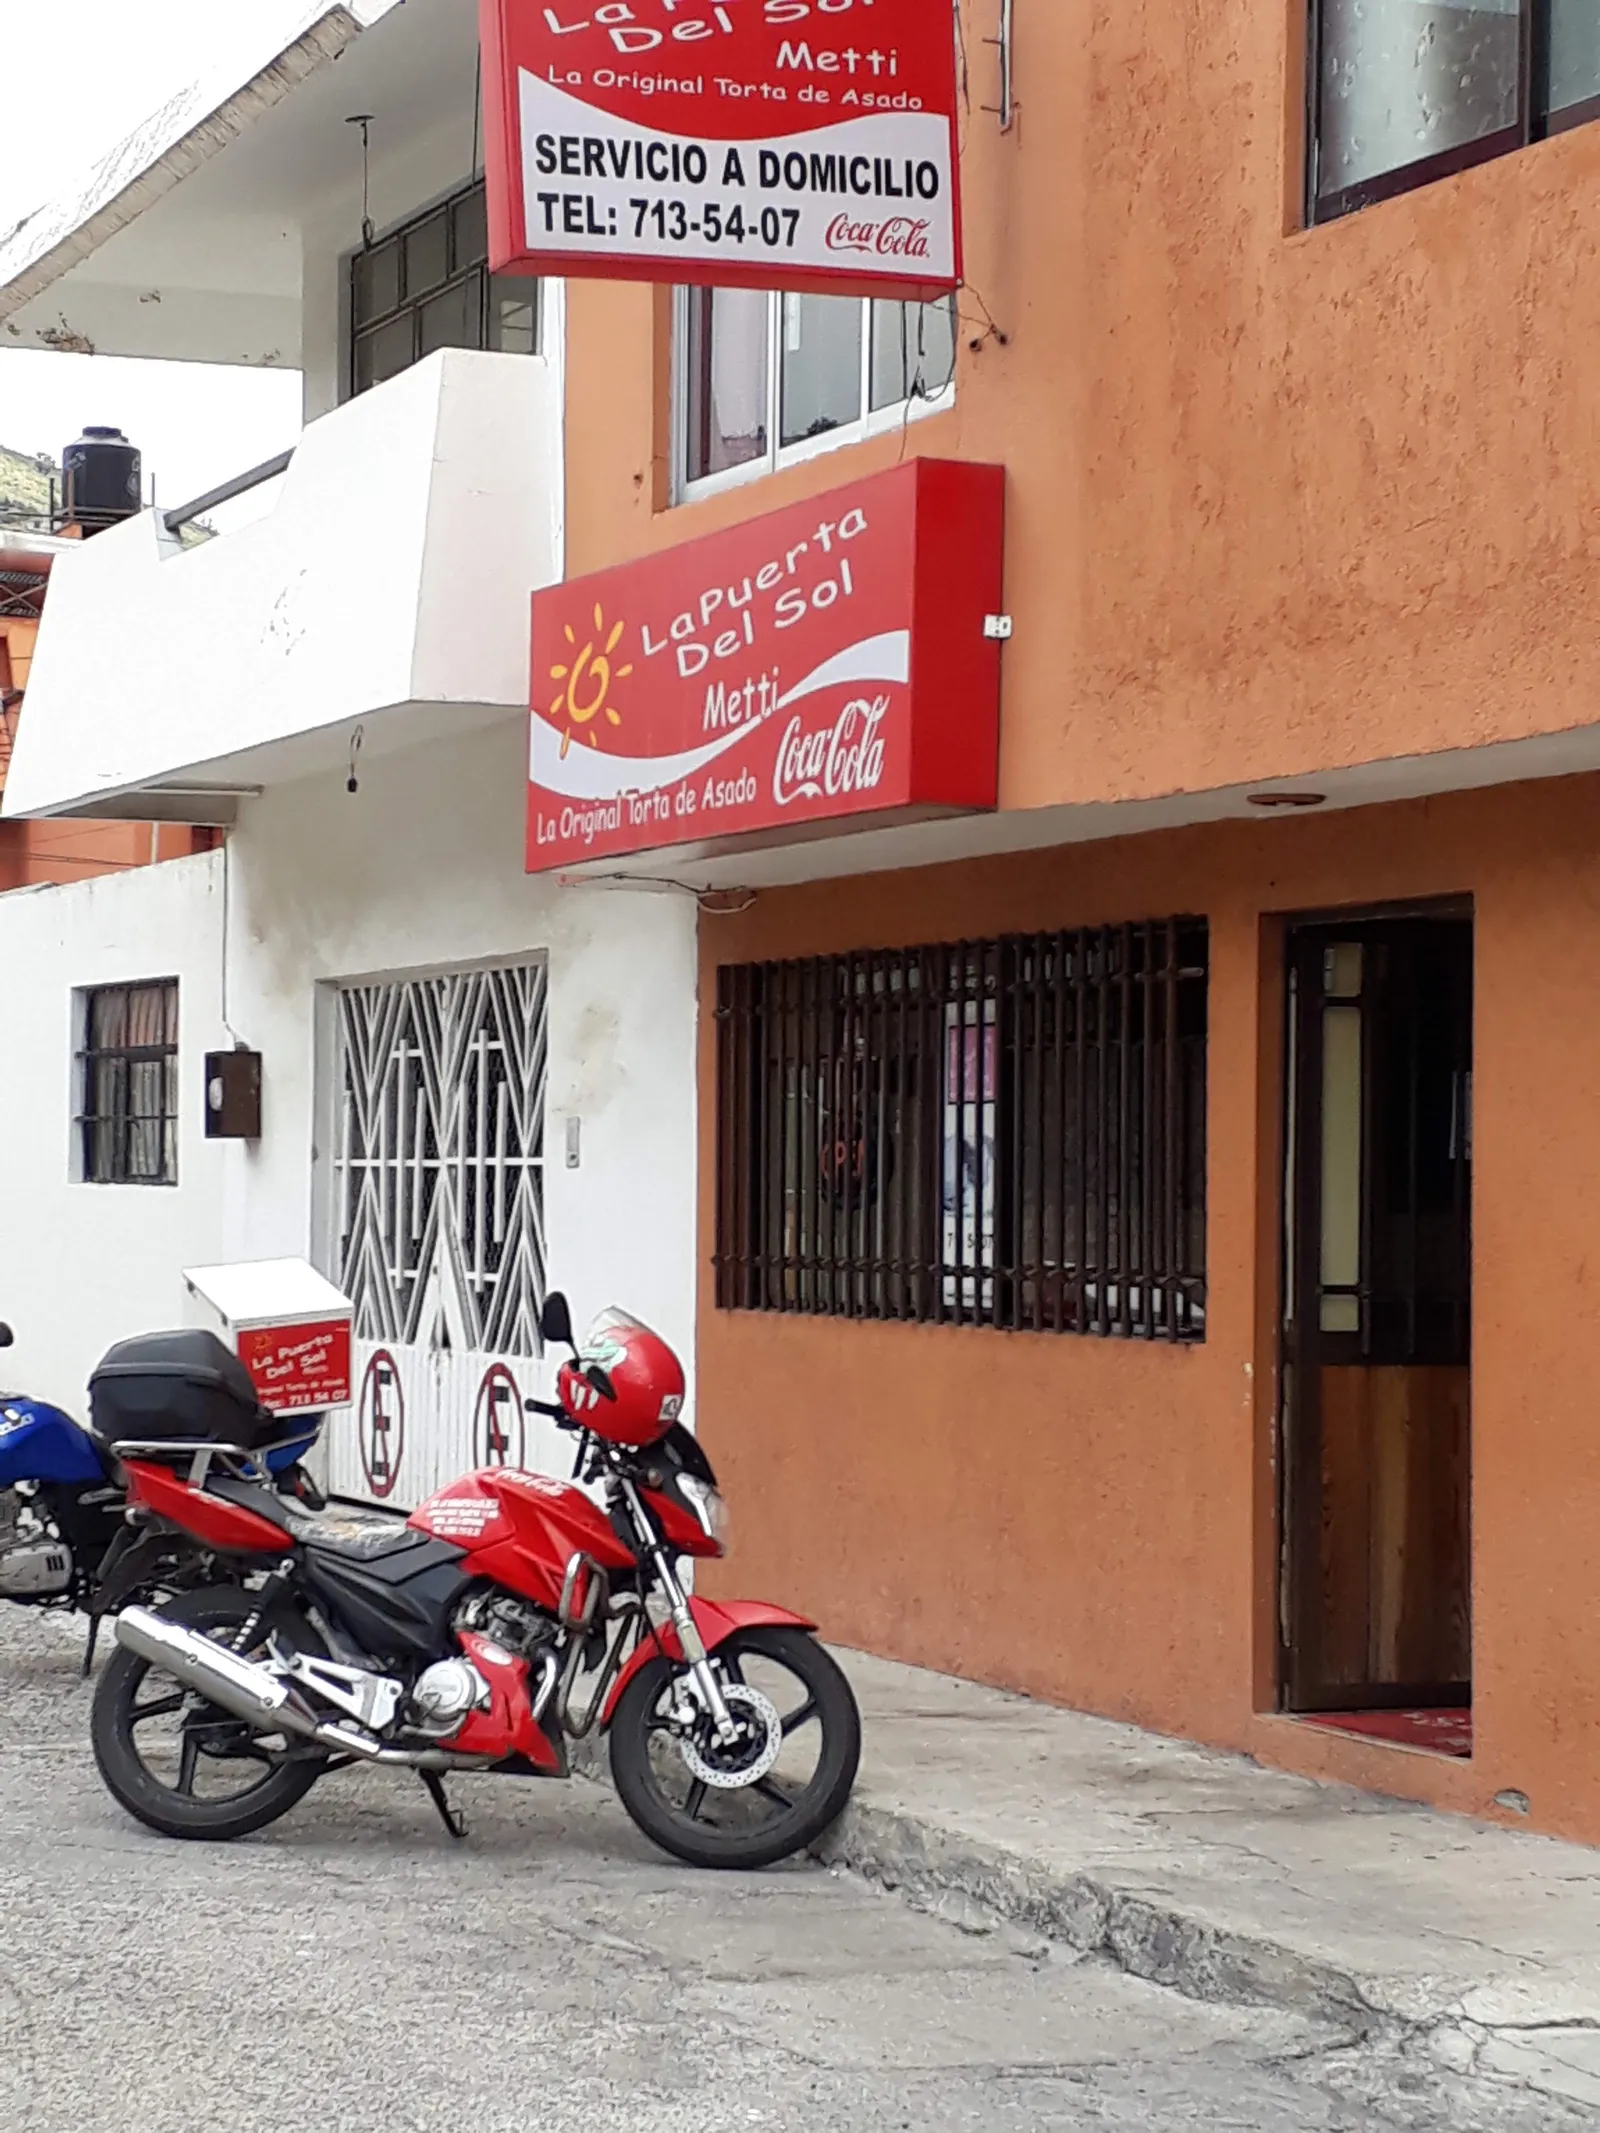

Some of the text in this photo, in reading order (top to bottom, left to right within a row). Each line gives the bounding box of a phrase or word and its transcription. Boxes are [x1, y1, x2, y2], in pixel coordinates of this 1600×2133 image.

[542, 2, 636, 35] La
[609, 0, 875, 53] Del So
[775, 40, 898, 77] Metti
[548, 64, 922, 111] La Original Torta de Asado
[535, 133, 940, 200] SERVICIO A DOMICILIO
[537, 193, 801, 248] TEL: 713-54-07
[825, 212, 931, 258] Coca-Cola
[675, 557, 853, 678] Del Sol
[703, 666, 779, 732] Metti
[773, 694, 890, 807] Coca-Cola
[536, 766, 757, 845] La Original Torta de Asado
